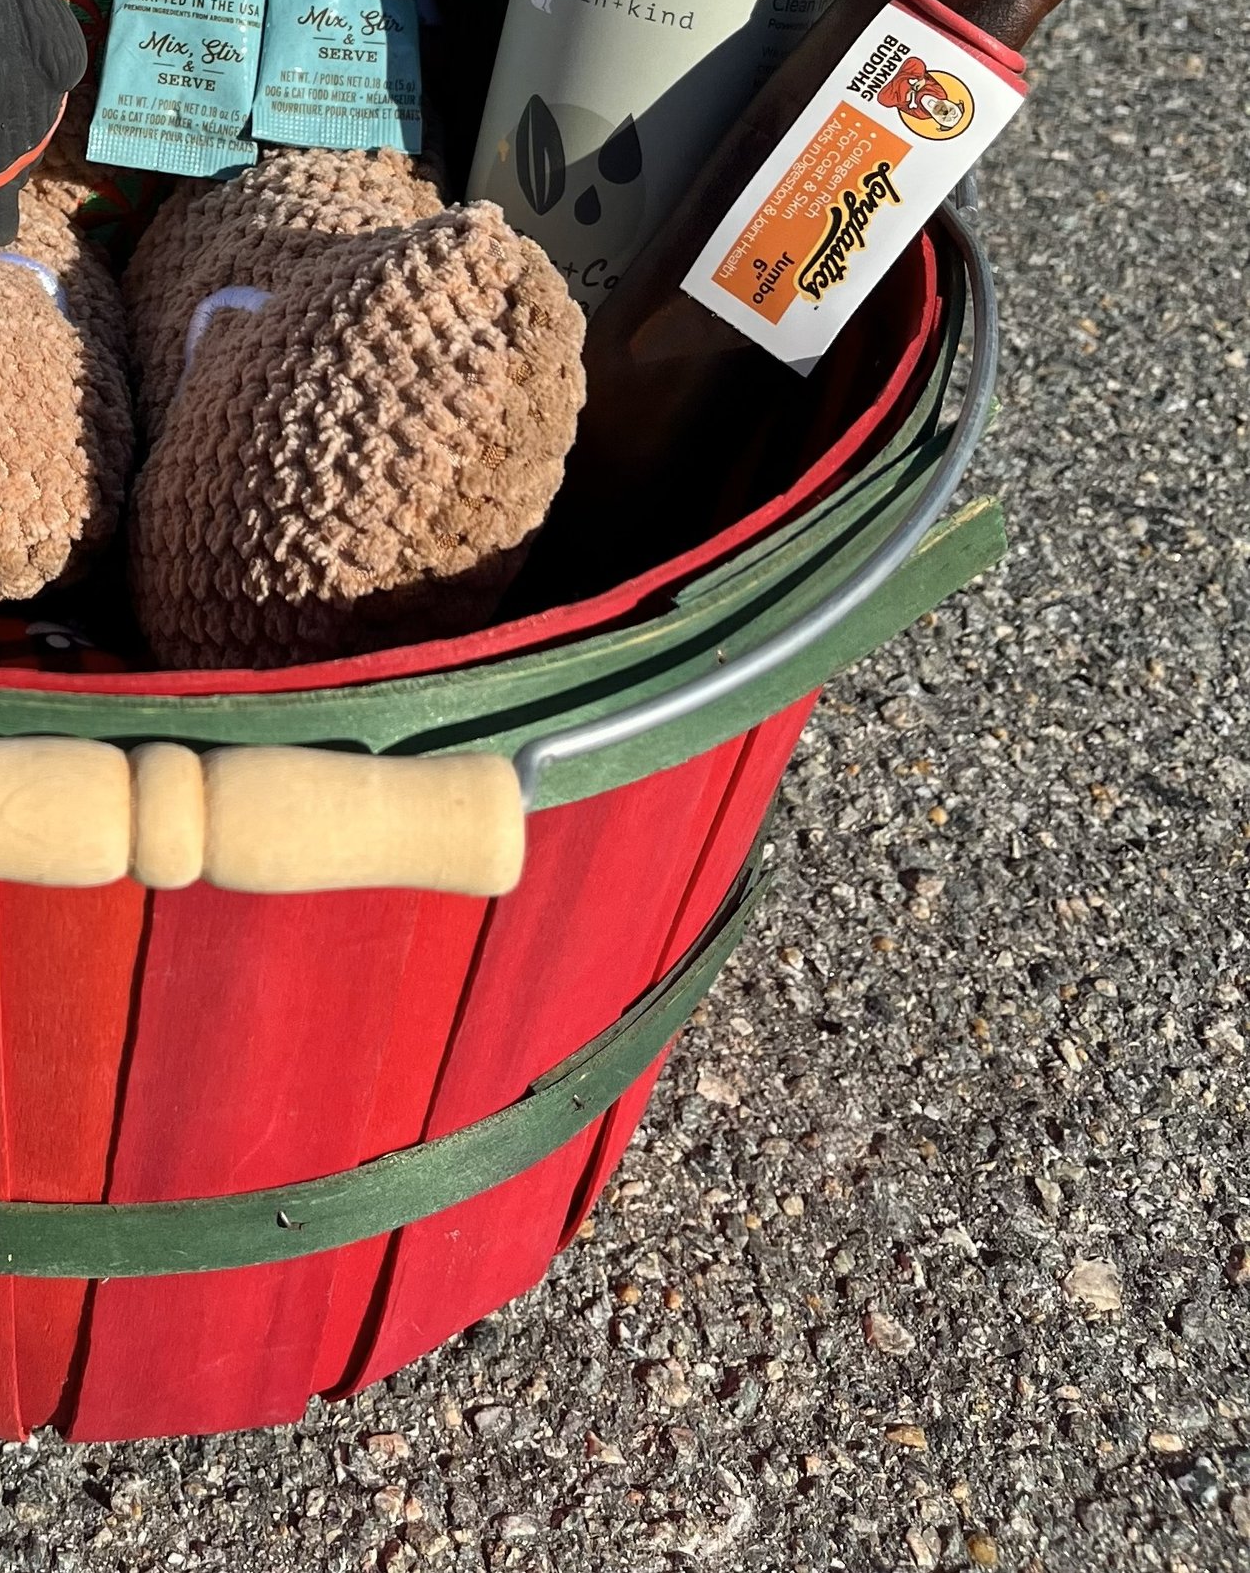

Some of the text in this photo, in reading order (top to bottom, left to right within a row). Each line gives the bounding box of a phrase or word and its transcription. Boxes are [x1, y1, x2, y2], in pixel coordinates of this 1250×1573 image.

[239, 3, 260, 17] USA
[297, 5, 404, 36] Mix, Stir
[139, 30, 244, 64] Mix, Stir
[343, 34, 356, 45] &
[182, 60, 195, 72] &
[318, 47, 378, 63] SERVE
[846, 34, 899, 94] BUDDHA
[157, 72, 216, 92] SERVE
[280, 70, 381, 89] NET POIDS NET 0.18
[861, 43, 911, 102] BARKING
[118, 94, 217, 118] NET POIDS NET 0.18
[264, 85, 282, 98] DOG
[291, 87, 307, 99] CAT
[308, 88, 329, 101] FOOD
[331, 90, 357, 103] MIXER
[102, 108, 118, 120] DOG
[128, 111, 143, 123] CAT
[145, 113, 166, 125] FOOD
[202, 118, 240, 137] MÉLANGE
[271, 101, 323, 115] NOURRITURE
[325, 105, 347, 117] POUR
[350, 107, 379, 120] CHIENS
[382, 108, 392, 119] ET
[161, 129, 182, 143] POUR
[228, 140, 254, 153] CHATS
[781, 128, 859, 220] For Coat & Skin
[805, 139, 872, 219] Collagen Rich
[718, 117, 842, 279] Aids in Digestion & Joint Health
[752, 251, 795, 305] Jumbo
